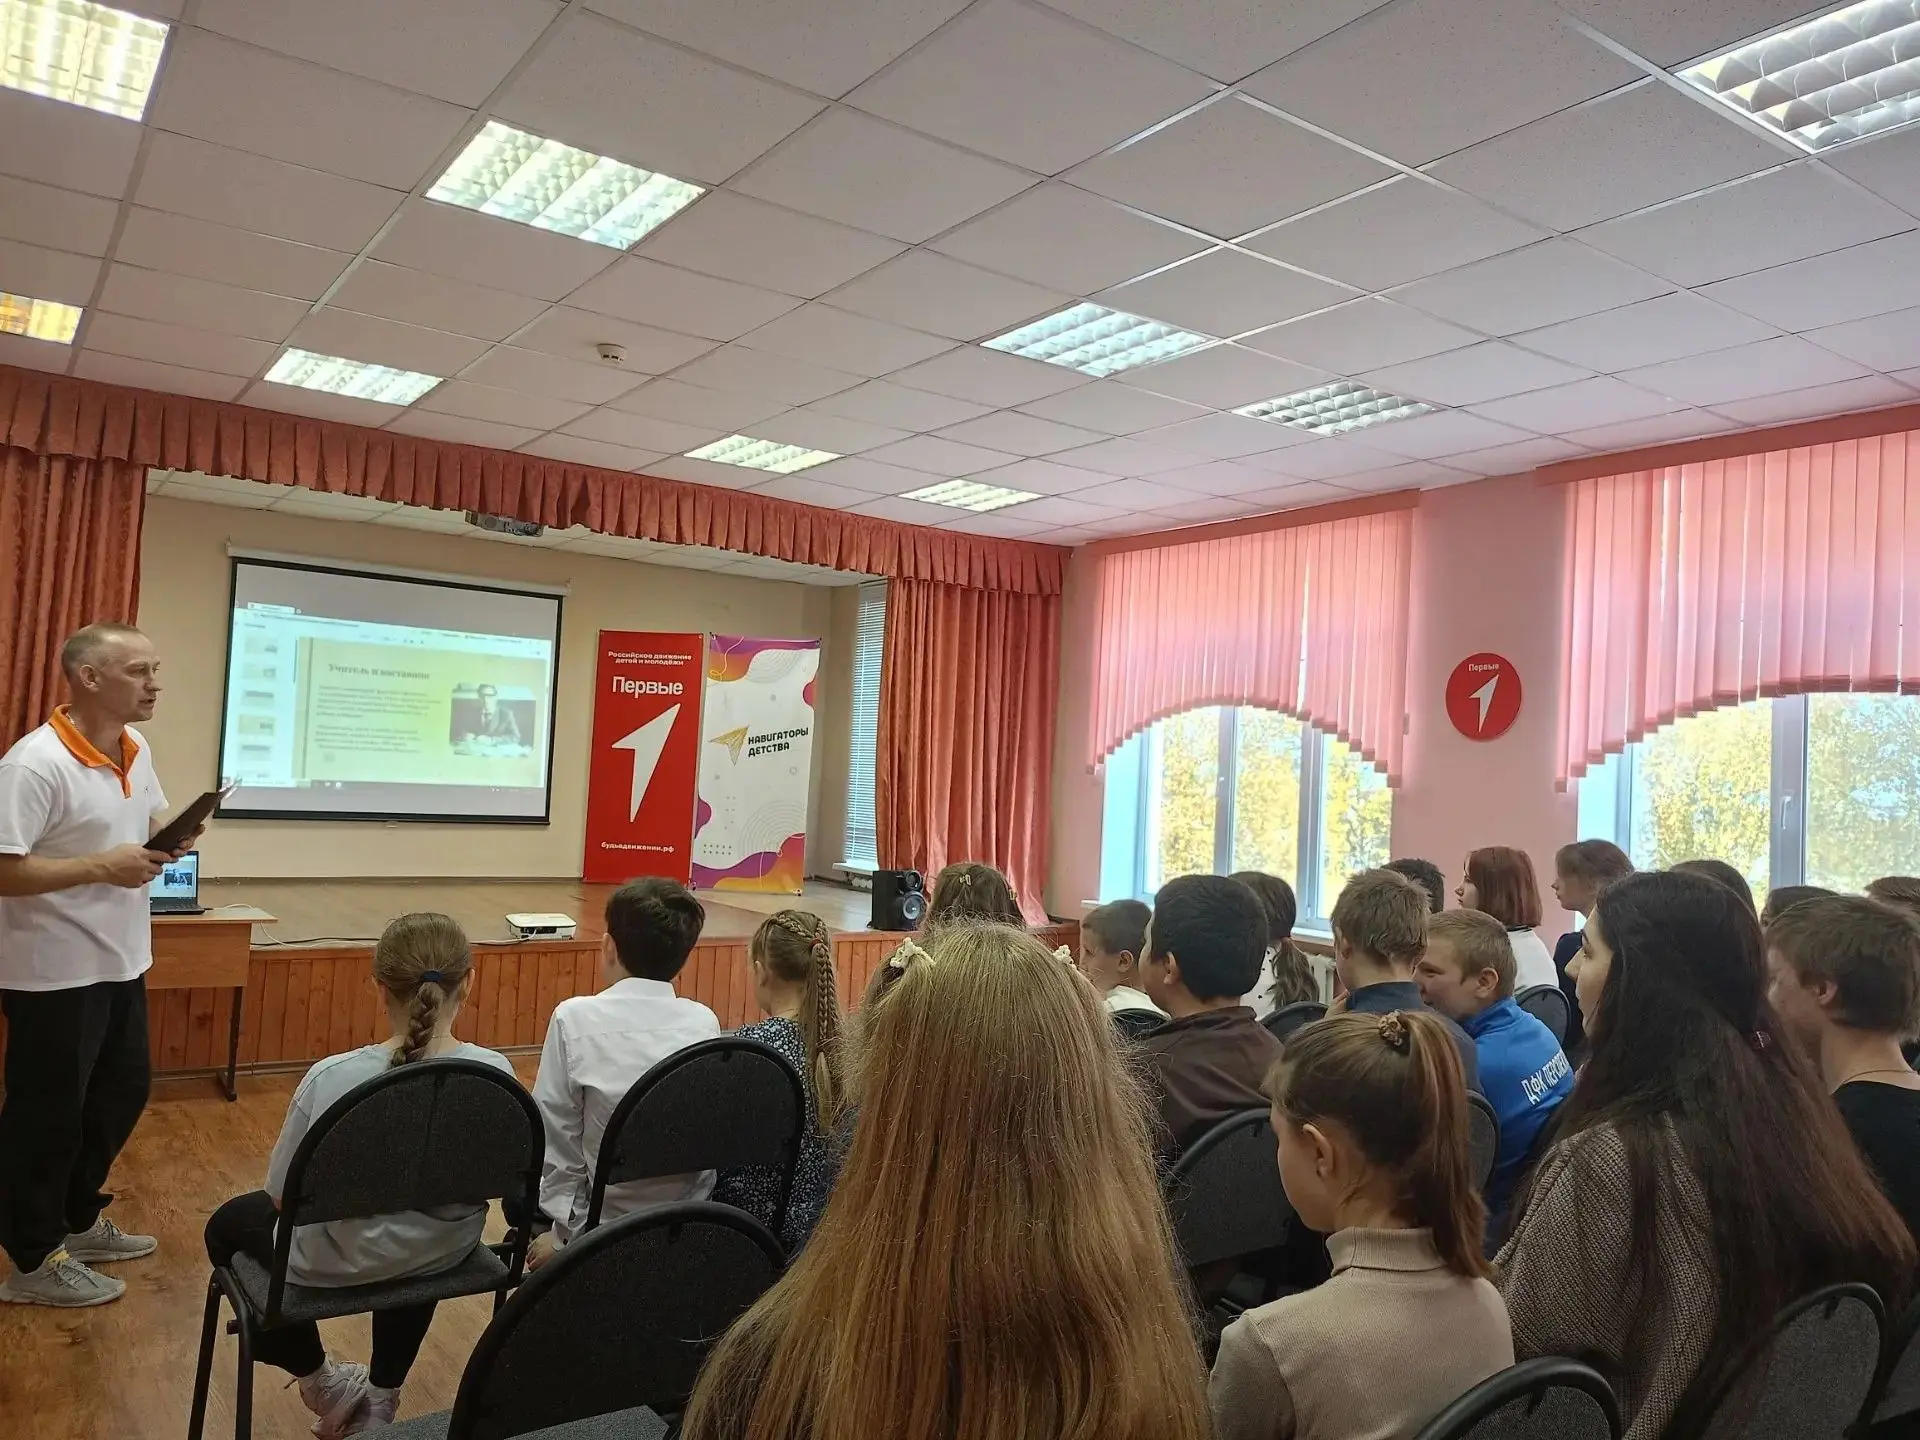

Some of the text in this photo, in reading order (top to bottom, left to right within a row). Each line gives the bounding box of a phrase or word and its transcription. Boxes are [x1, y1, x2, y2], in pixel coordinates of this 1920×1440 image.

[607, 651, 653, 659] Российское
[1468, 663, 1500, 673] Первые
[612, 676, 684, 699] Первые
[748, 727, 809, 745] НАВИГАТОРЫ
[748, 742, 790, 758] ДЕТСТВА
[1520, 1069, 1549, 1105] ДФК
